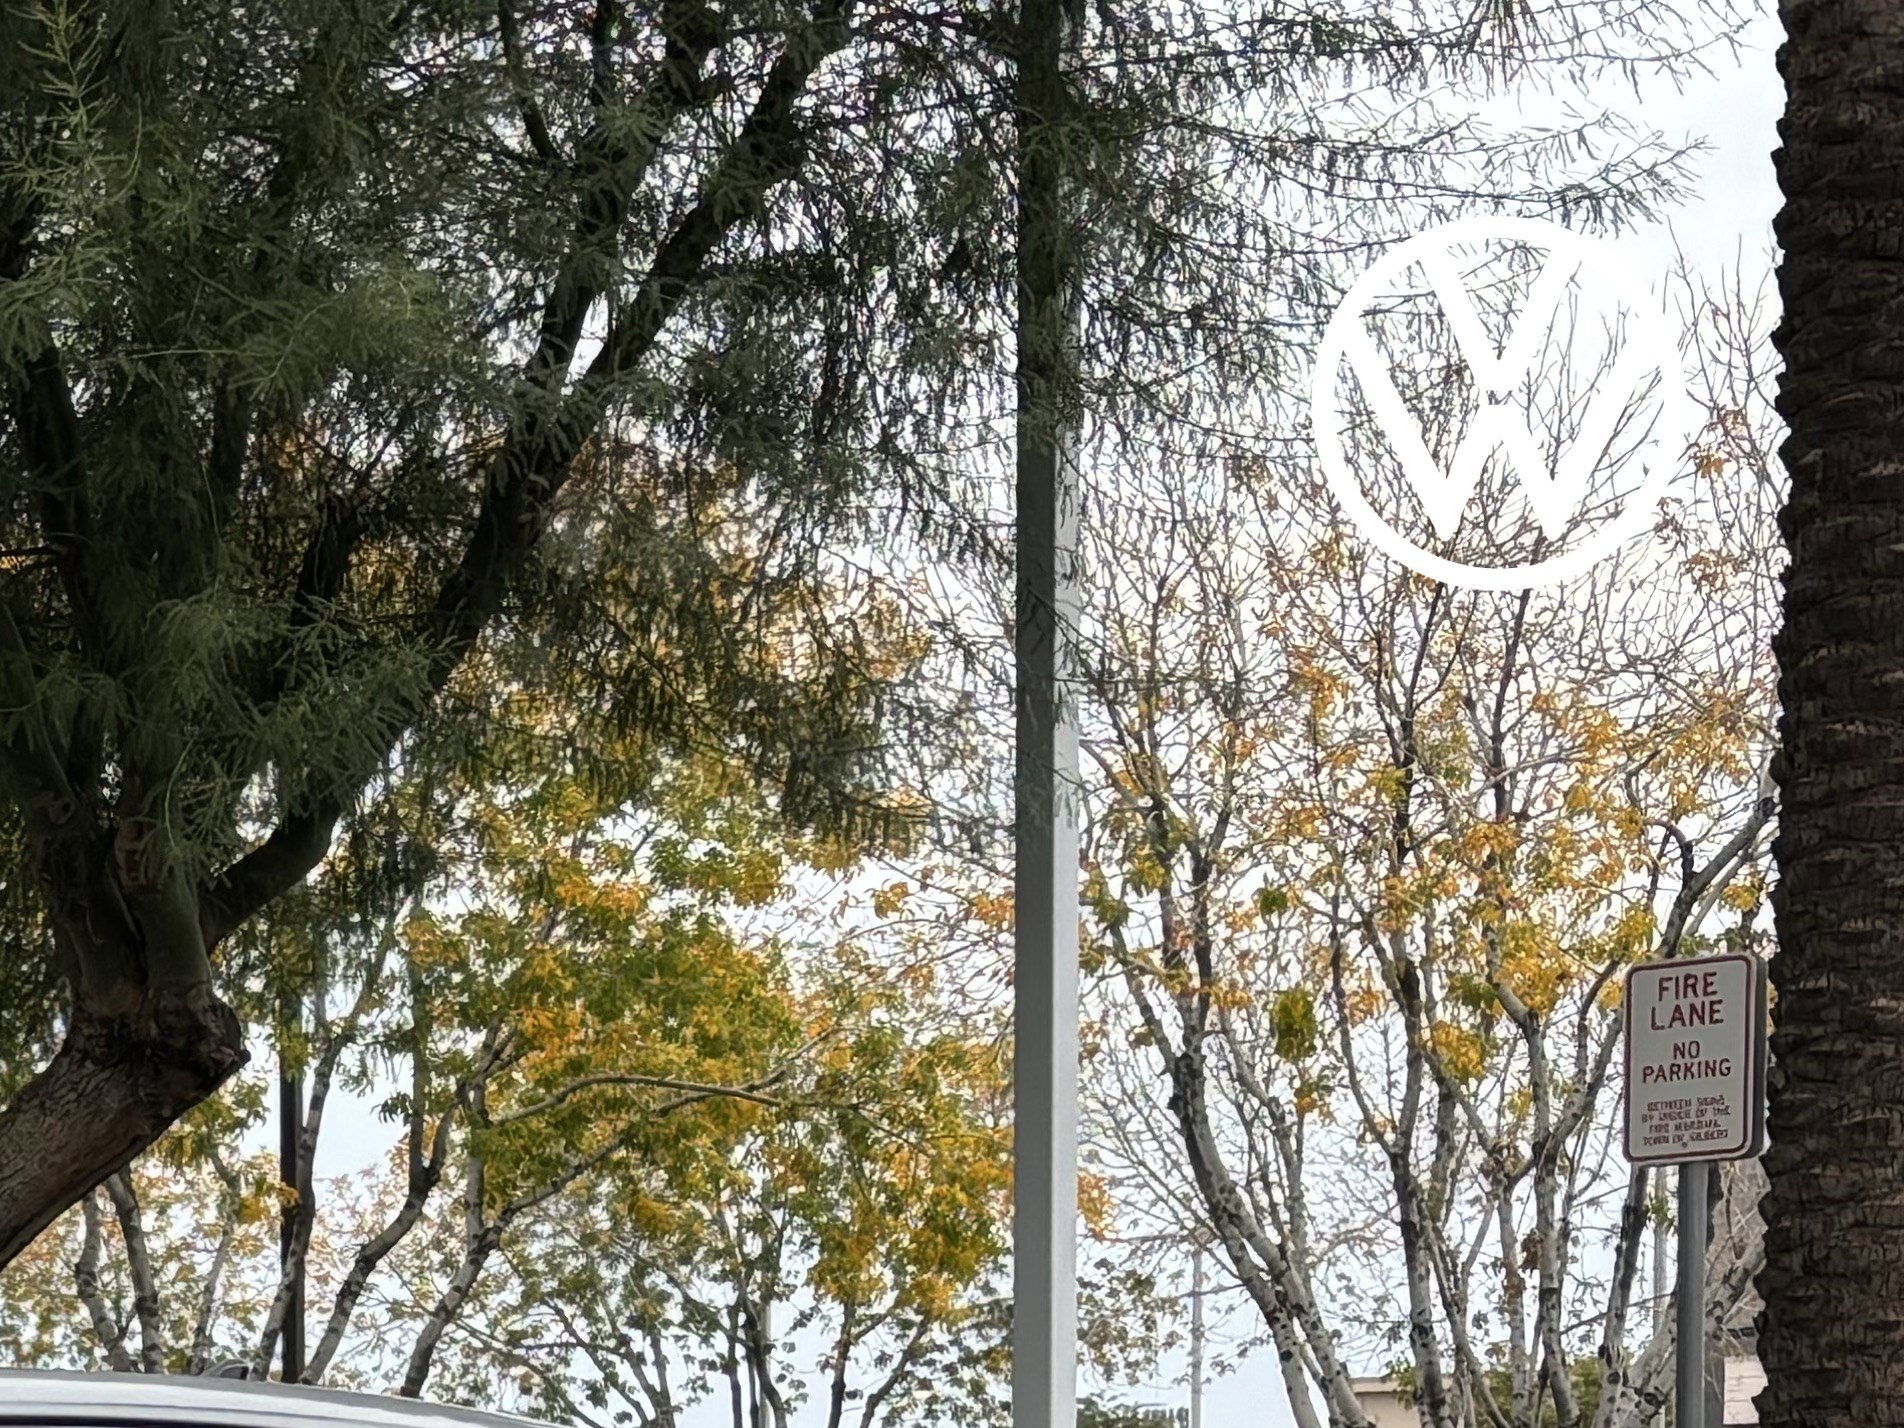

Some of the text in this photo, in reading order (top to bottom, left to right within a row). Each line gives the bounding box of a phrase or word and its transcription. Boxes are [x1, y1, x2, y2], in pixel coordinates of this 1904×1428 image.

[1658, 971, 1718, 1002] FIRE
[1650, 999, 1724, 1031] LANE
[1673, 1040, 1700, 1060] NO
[1642, 1057, 1732, 1084] PARKING
